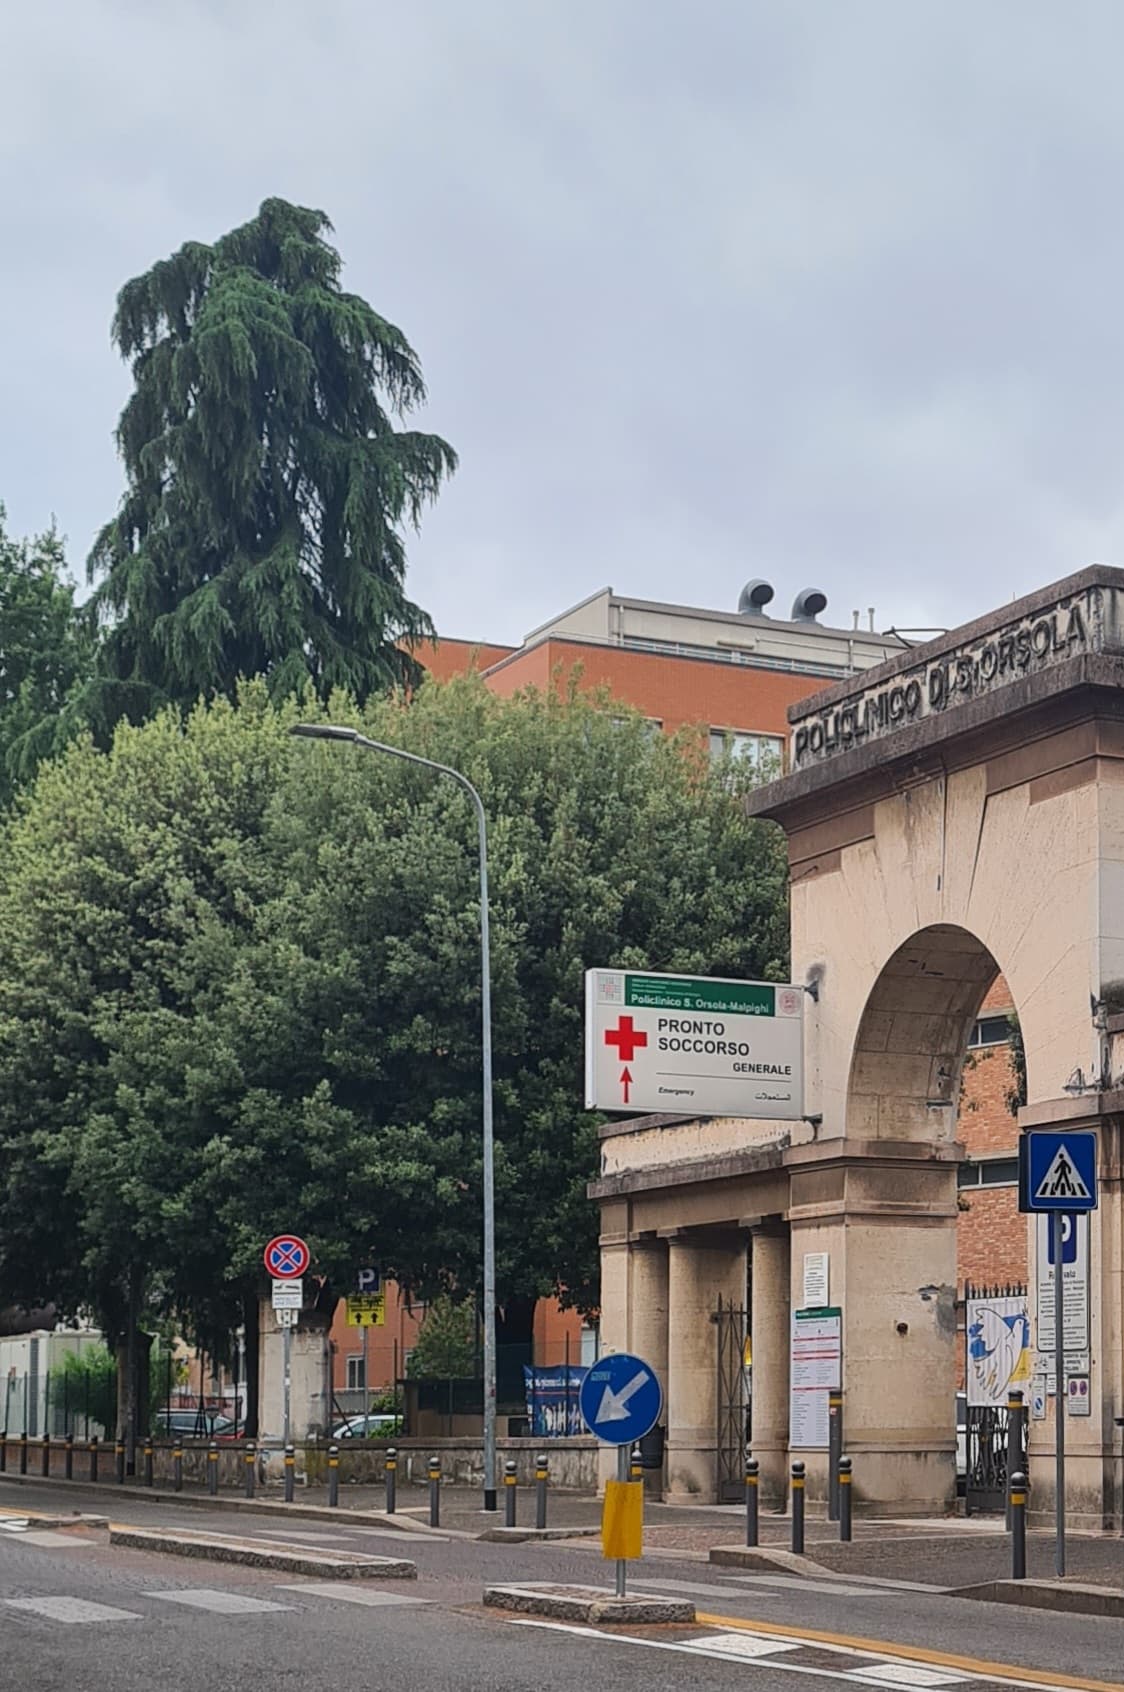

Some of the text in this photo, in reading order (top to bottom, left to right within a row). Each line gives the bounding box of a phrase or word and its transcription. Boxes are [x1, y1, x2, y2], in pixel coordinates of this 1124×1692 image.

[795, 680, 921, 760] POLICLINICO
[929, 663, 950, 709] DI
[980, 605, 1088, 681] ORSOLA
[631, 994, 769, 1014] Policlinico S. Orsola-Malpighi
[658, 1018, 725, 1036] PRONTO
[658, 1037, 750, 1056] SOCCORSO
[732, 1062, 792, 1075] GENERALE
[658, 1086, 695, 1097] Emergency
[358, 1268, 375, 1291] P
